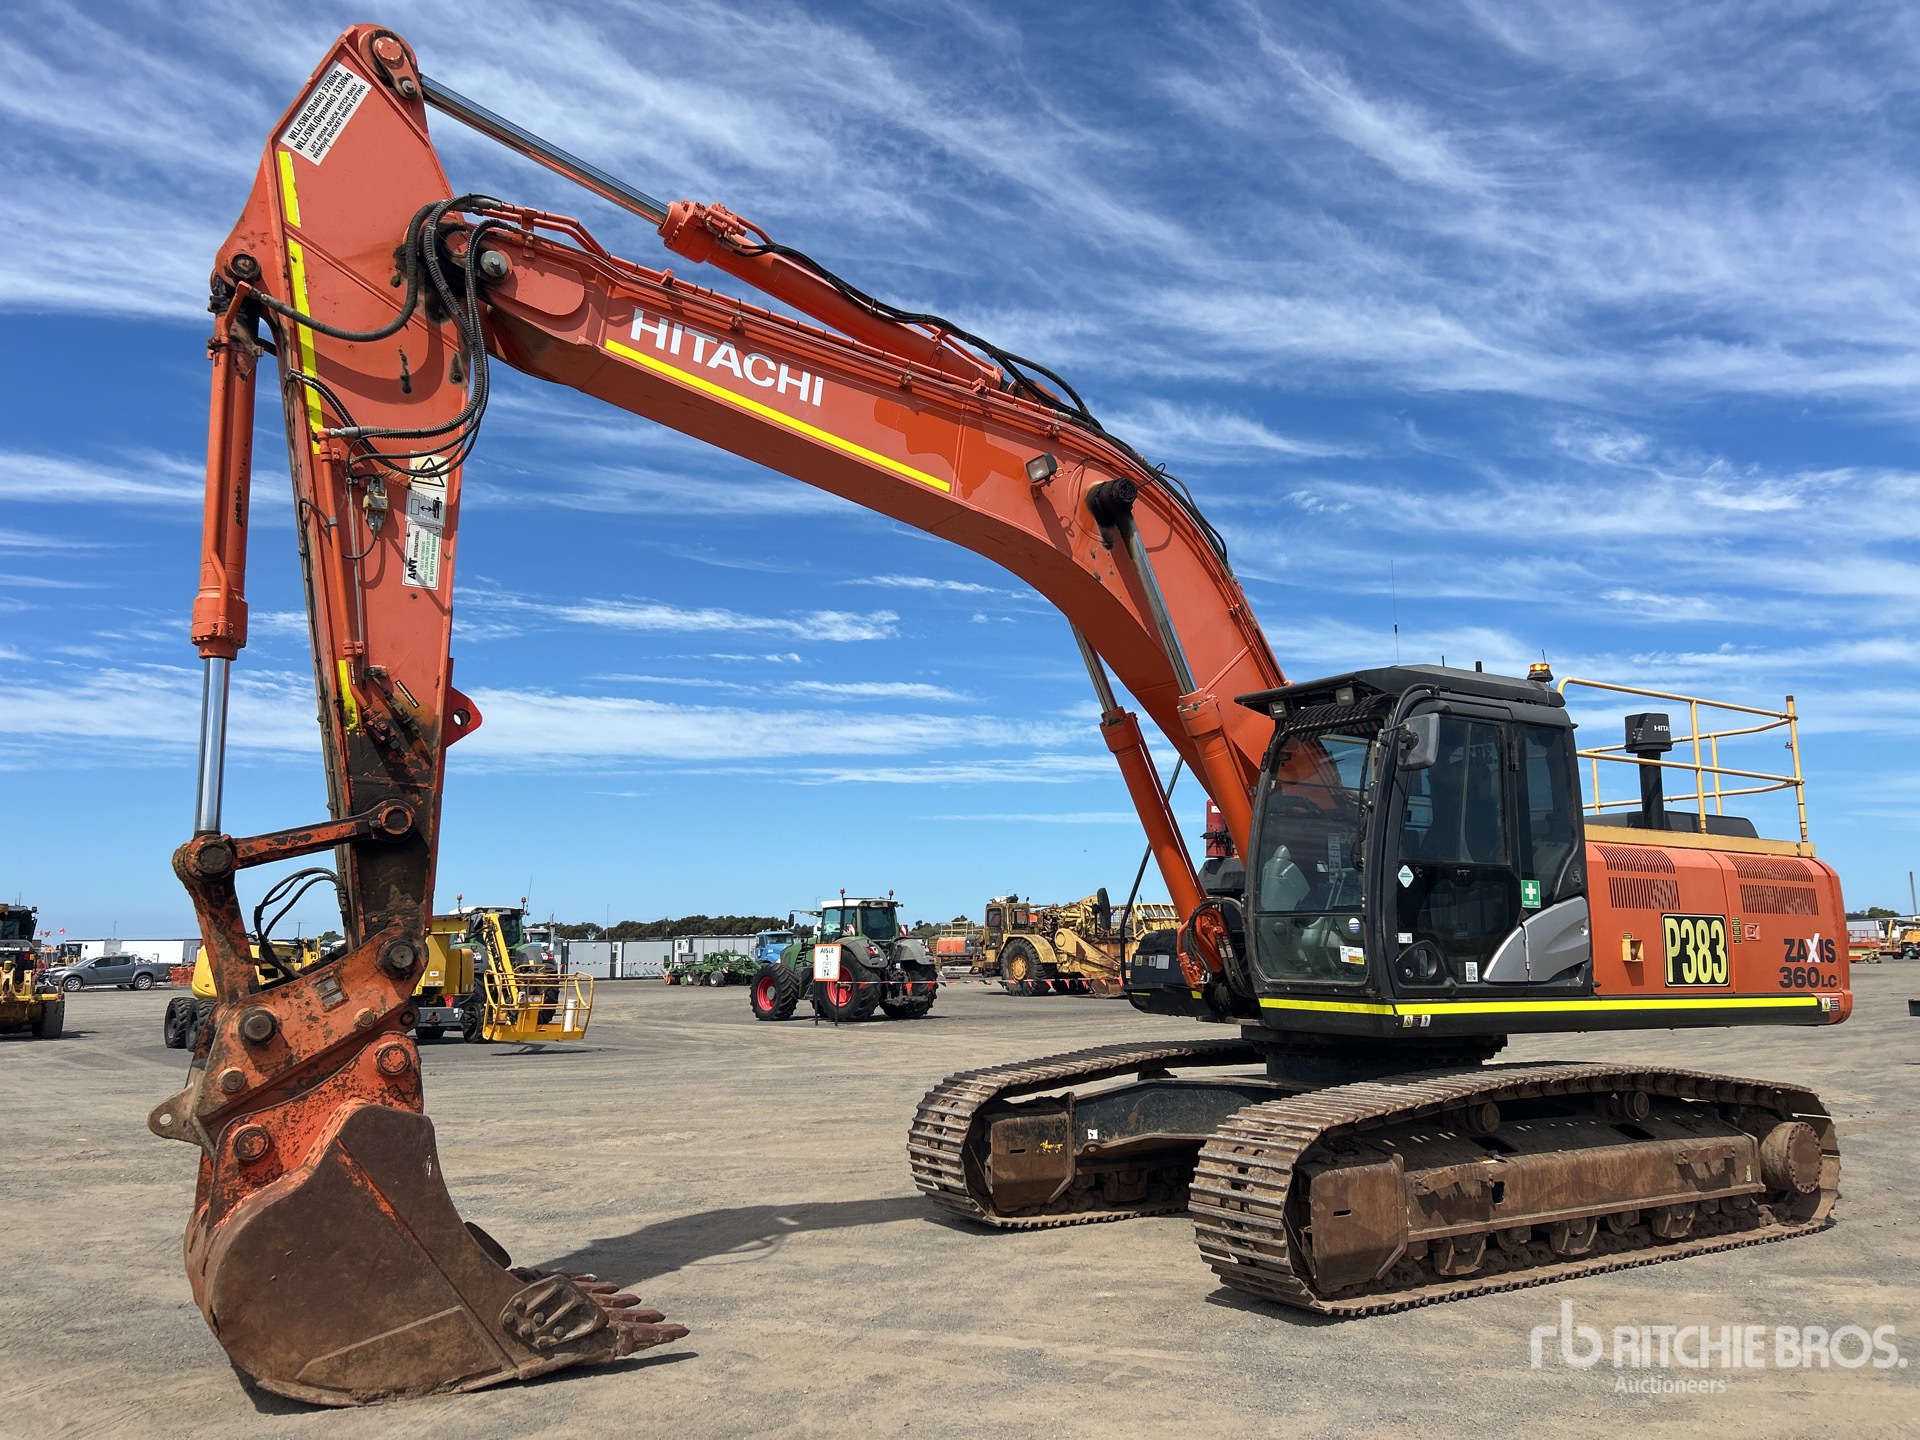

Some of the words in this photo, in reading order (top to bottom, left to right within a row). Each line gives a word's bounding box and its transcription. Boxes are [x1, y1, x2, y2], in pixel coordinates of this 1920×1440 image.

[288, 92, 324, 140] WLL/SWL(Static)
[322, 70, 342, 93] 3780kg
[294, 94, 338, 150] WLL/SWL(Dynamic)
[333, 72, 353, 95] 3330kg
[309, 139, 320, 152] LIFT
[317, 126, 329, 142] FROM
[327, 109, 341, 126] QUICK
[337, 95, 351, 111] HITCH
[348, 82, 358, 98] ONLY
[313, 138, 329, 159] REMOVE
[328, 116, 343, 138] BUCKET
[341, 103, 353, 118] WHEN
[351, 84, 365, 104] LIFTING
[630, 307, 824, 406] HITACHI
[1664, 918, 1727, 984] P383
[1784, 932, 1836, 963] ZAXIS
